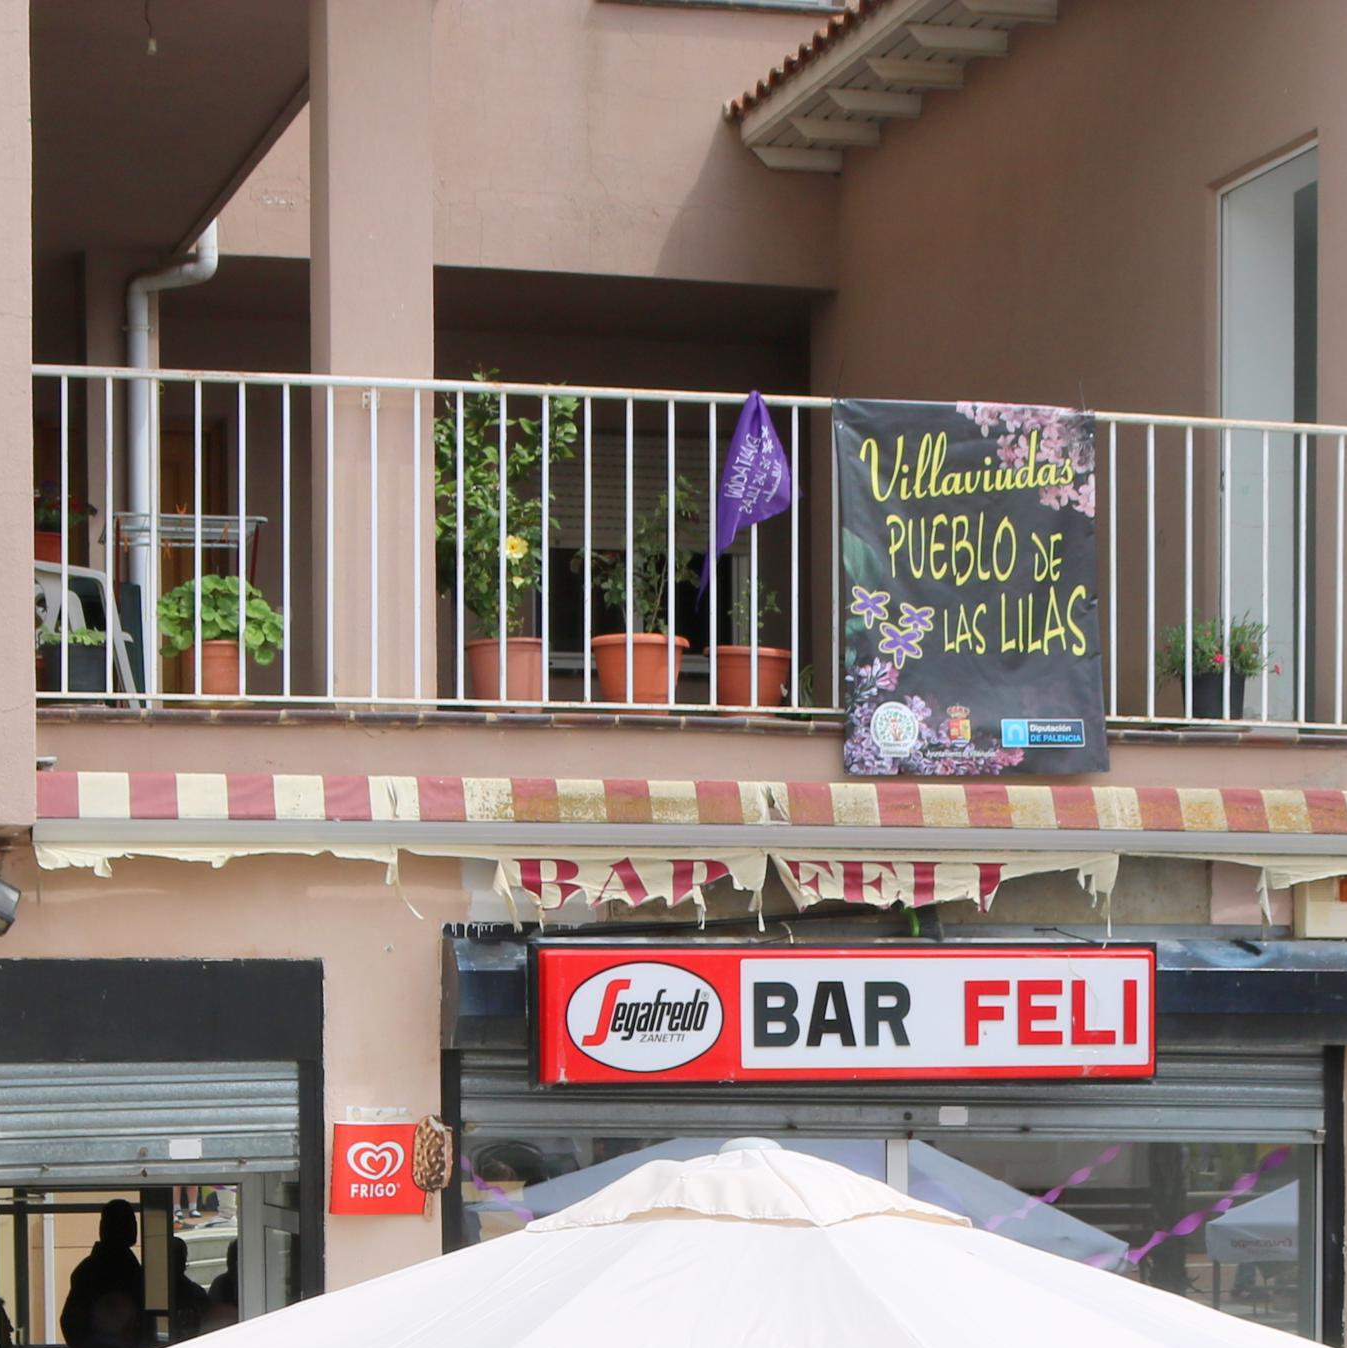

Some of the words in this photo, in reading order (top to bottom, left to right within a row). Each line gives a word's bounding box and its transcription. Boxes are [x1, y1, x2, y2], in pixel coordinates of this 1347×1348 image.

[859, 429, 1075, 502] Villaviudas
[886, 511, 1018, 587] PUEBLO
[1031, 532, 1063, 583] DE
[943, 603, 988, 656] LAS
[1001, 584, 1087, 657] LILAS
[581, 978, 709, 1047] Segafredo
[638, 1033, 685, 1044] ZANETTI
[753, 981, 911, 1047] BAR
[964, 979, 1138, 1046] FELI
[350, 1183, 397, 1199] FRIGO
